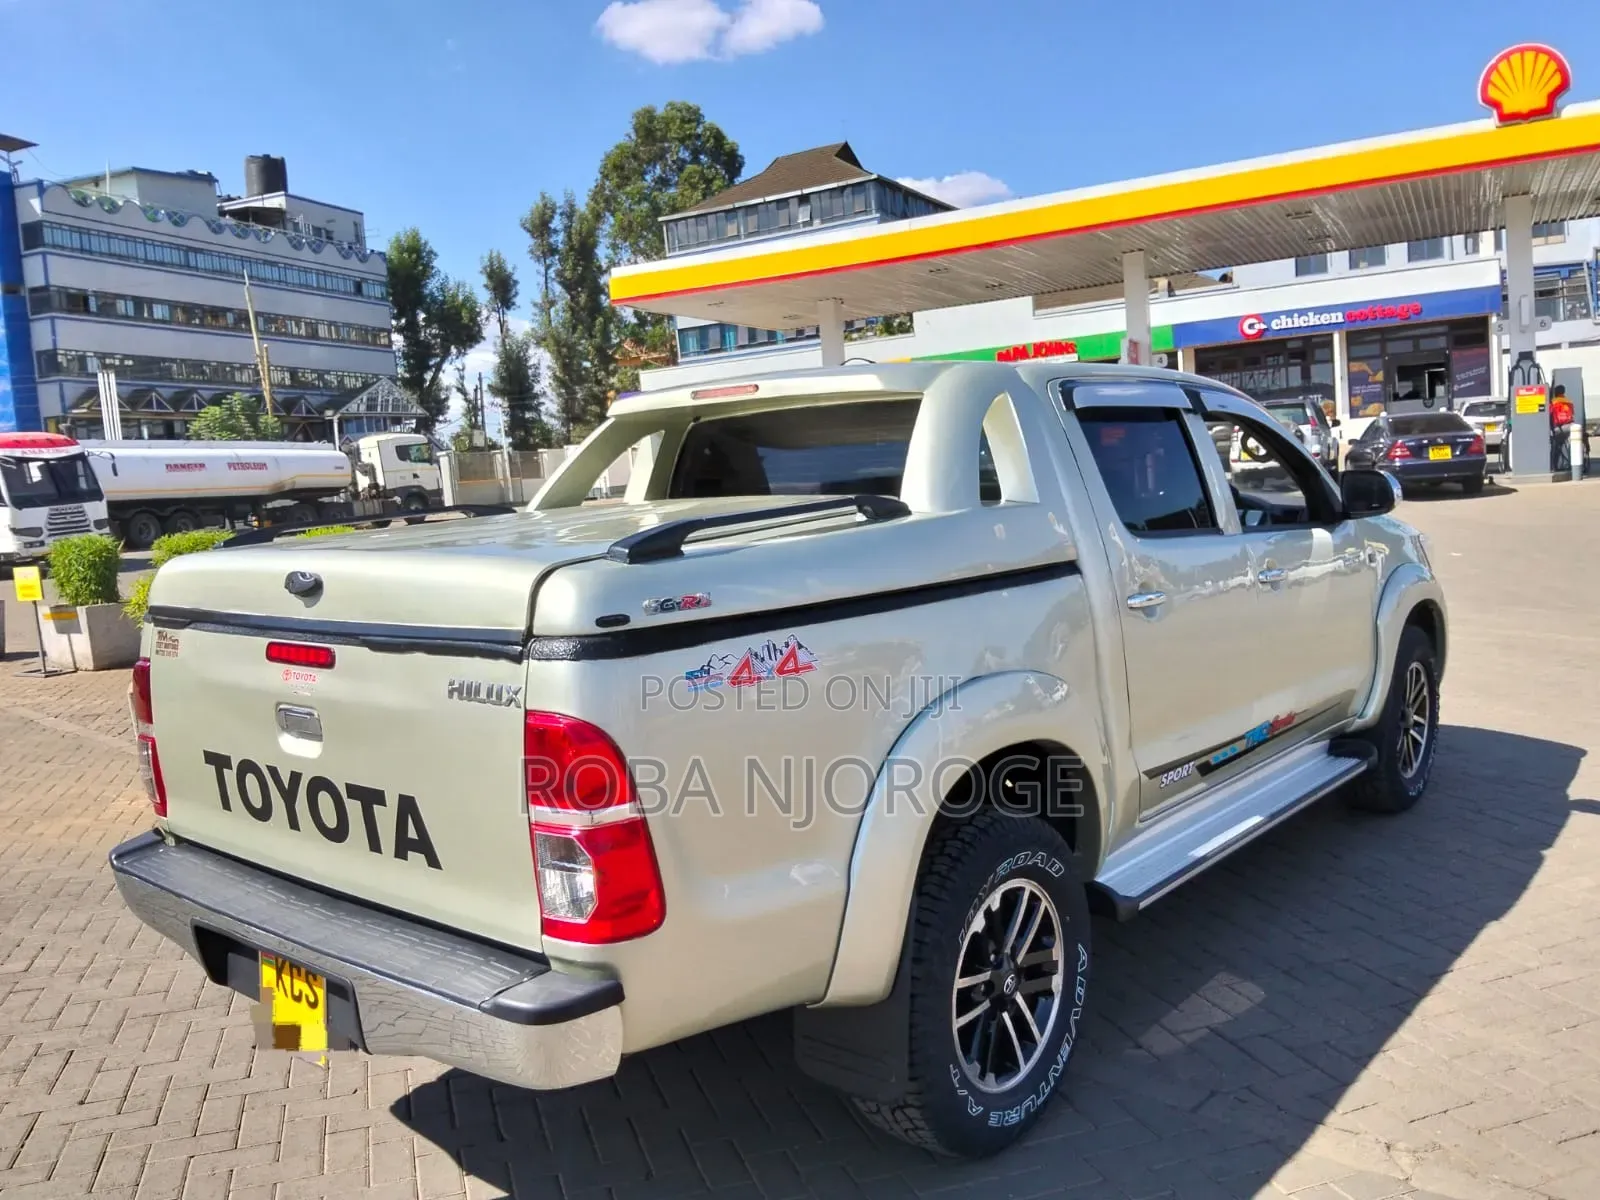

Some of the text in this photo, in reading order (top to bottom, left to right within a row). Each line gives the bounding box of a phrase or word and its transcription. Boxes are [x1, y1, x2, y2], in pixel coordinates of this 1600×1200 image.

[1271, 311, 1345, 330] chicken
[1345, 302, 1421, 320] cottage
[227, 461, 268, 471] PETROLEUM
[292, 671, 317, 682] TOYOTA
[447, 679, 523, 708] HILUX
[1159, 761, 1195, 788] SPORT
[202, 749, 443, 871] TOYOTA
[274, 956, 319, 1010] KCS
[987, 942, 1089, 1128] ADVENTURE
[949, 1063, 984, 1117] A/T
